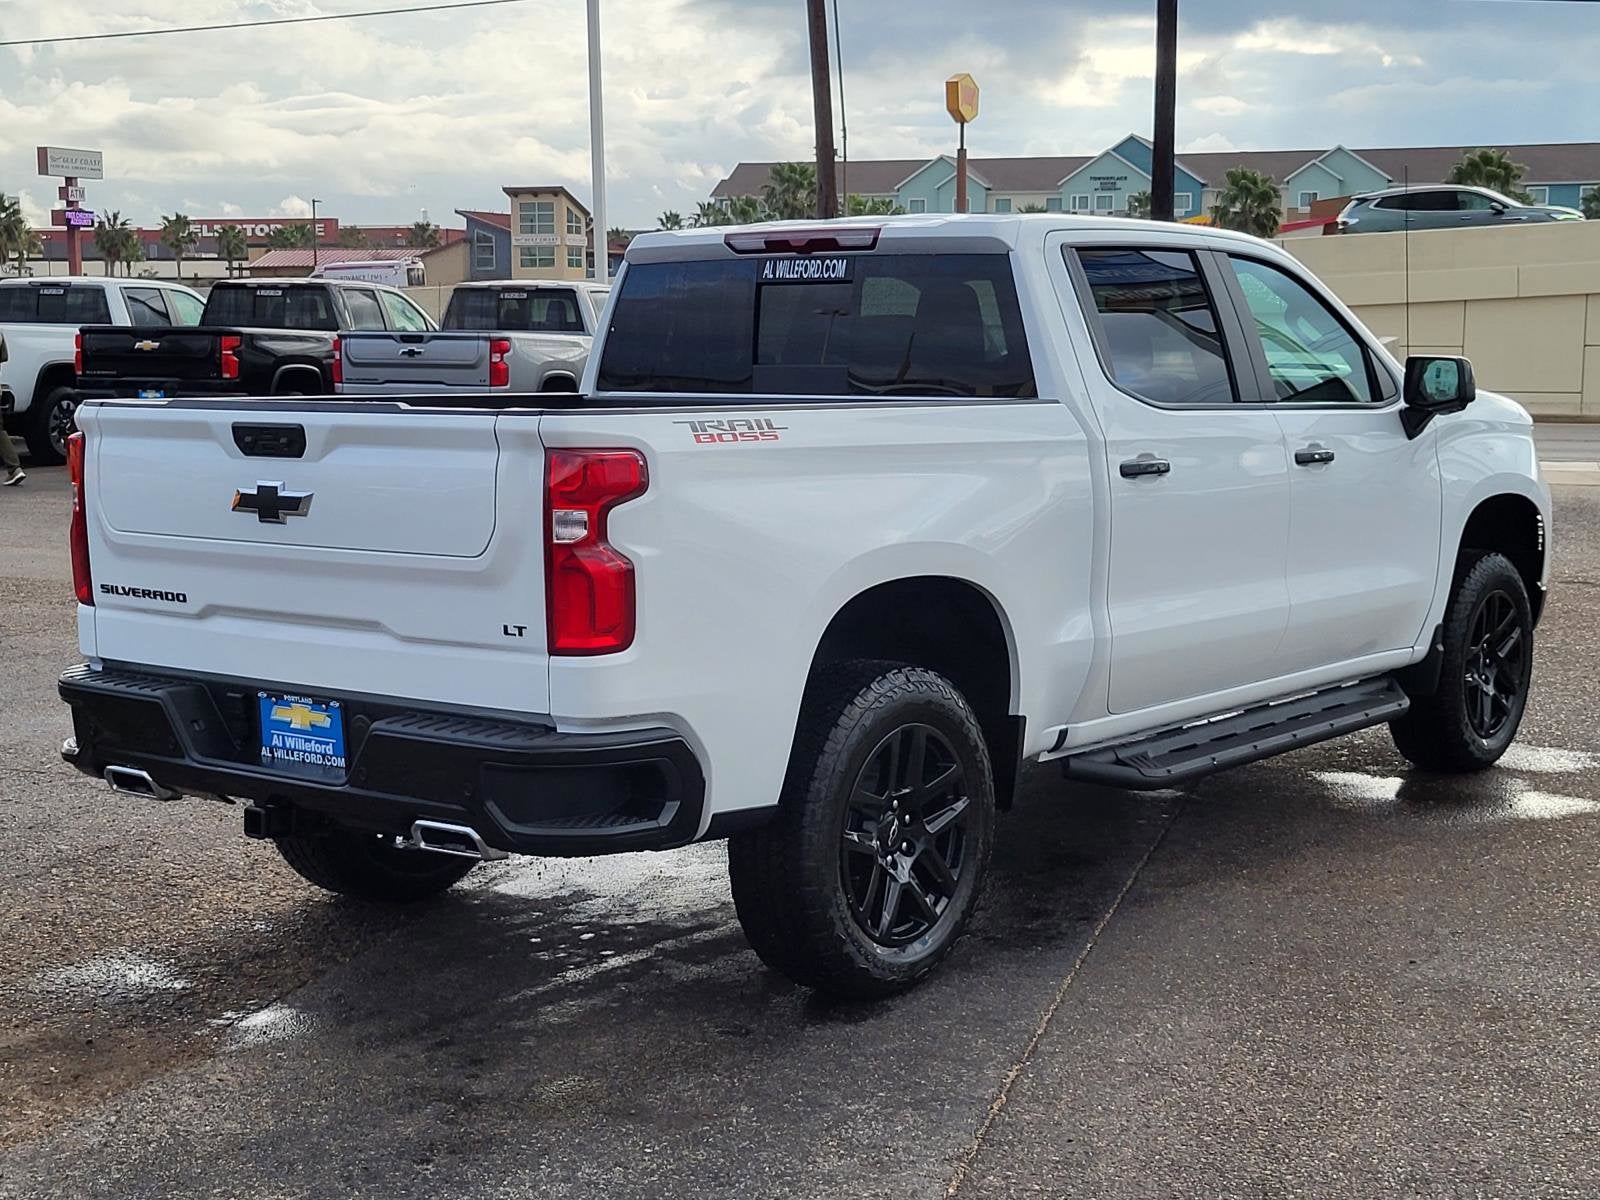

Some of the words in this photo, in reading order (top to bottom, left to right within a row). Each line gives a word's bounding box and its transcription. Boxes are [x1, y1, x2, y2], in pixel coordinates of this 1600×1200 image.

[62, 156, 78, 164] GULF
[80, 158, 101, 167] COAST
[70, 189, 85, 199] ATM
[762, 260, 774, 279] AL
[776, 259, 847, 279] WILLEFORD.COM
[672, 418, 789, 433] TRAIL
[693, 431, 779, 444] BOSS
[100, 584, 187, 603] SILVERADO
[503, 624, 527, 637] LT
[284, 694, 313, 704] PORTLAND
[272, 734, 283, 747] Al
[285, 735, 333, 755] Willeford
[261, 746, 273, 757] AL
[273, 748, 346, 768] WILLEFORD.COM
